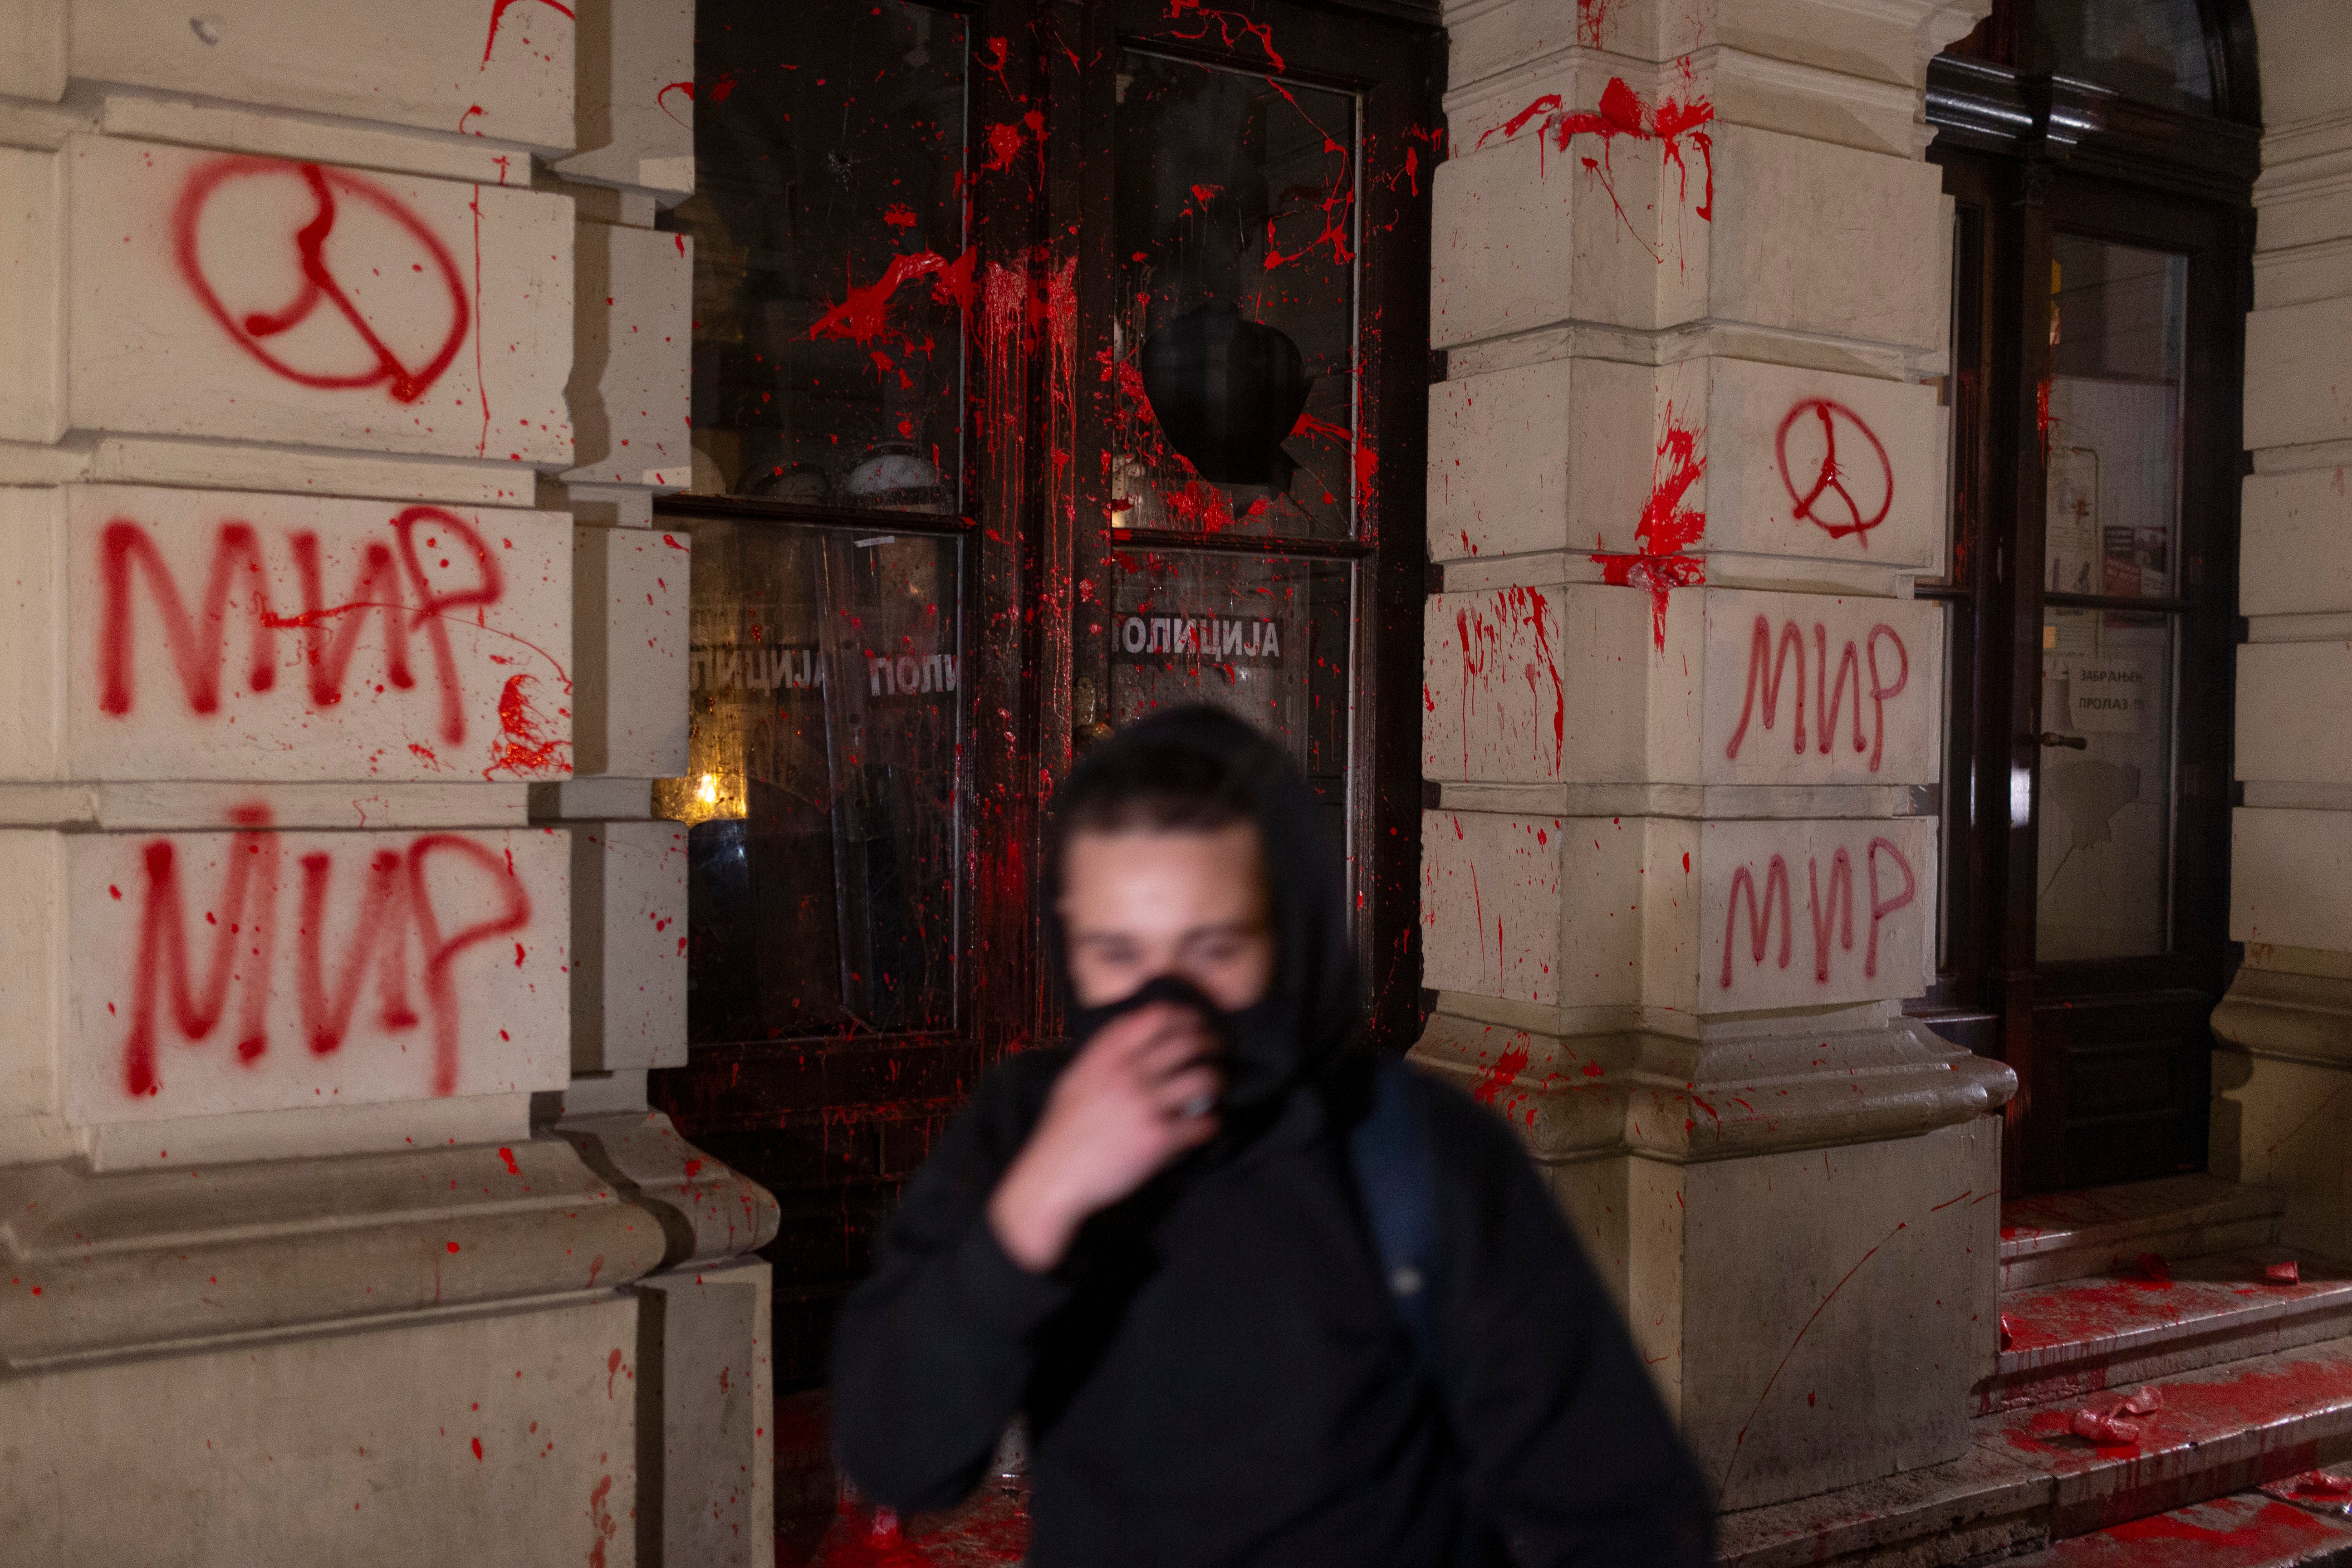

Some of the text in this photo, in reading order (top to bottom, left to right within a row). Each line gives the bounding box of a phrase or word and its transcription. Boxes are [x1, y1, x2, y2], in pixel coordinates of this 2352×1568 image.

[97, 505, 504, 748] МИР
[1726, 613, 1909, 773] МИР
[2079, 697, 2127, 710] ПРОЛАЗ
[122, 799, 532, 1097] МИР
[1721, 836, 1916, 989] МИР
